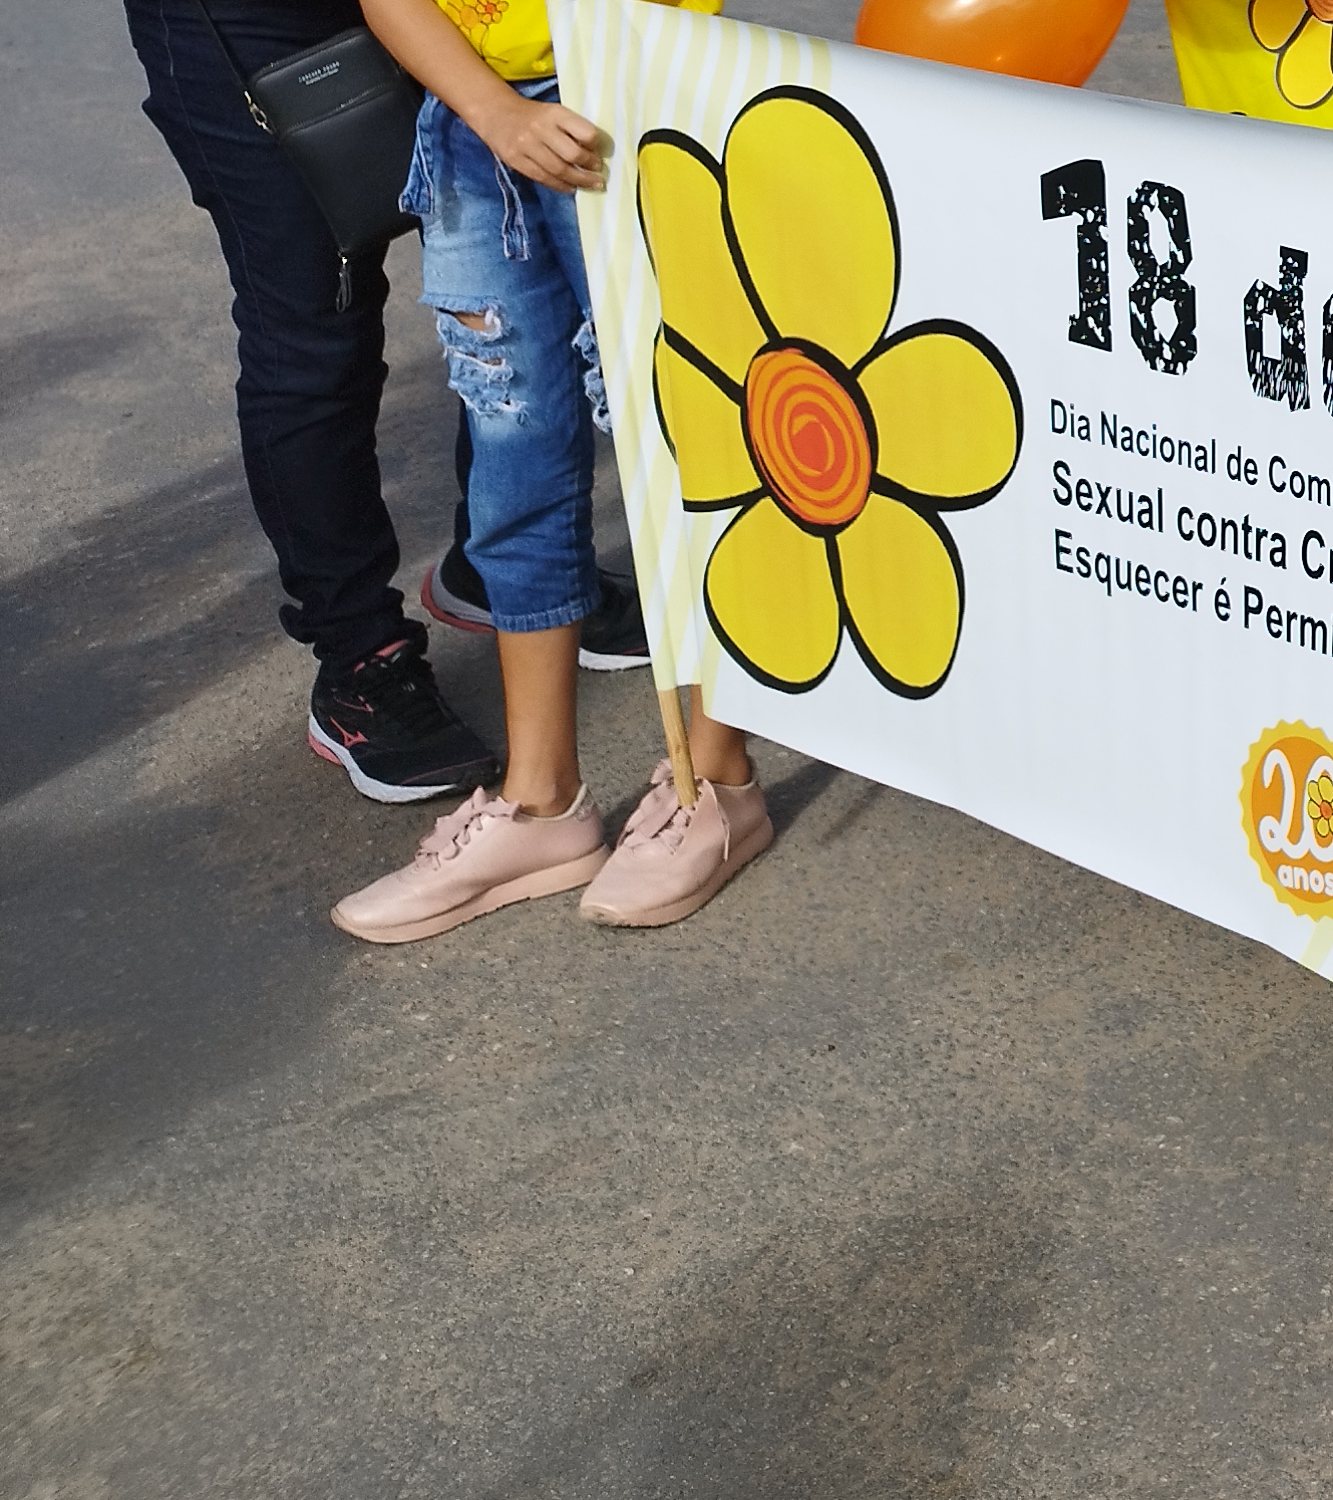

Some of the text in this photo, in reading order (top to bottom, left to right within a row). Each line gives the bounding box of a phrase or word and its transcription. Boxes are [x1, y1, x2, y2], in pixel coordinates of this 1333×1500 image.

[1040, 158, 1198, 376] 18
[1050, 398, 1091, 442] Dia
[1100, 410, 1217, 475] Nacional
[1226, 445, 1259, 486] de
[1052, 460, 1164, 533] Sexual
[1177, 506, 1288, 570] contra
[1054, 527, 1204, 614] Esquecer
[1213, 576, 1232, 623] é
